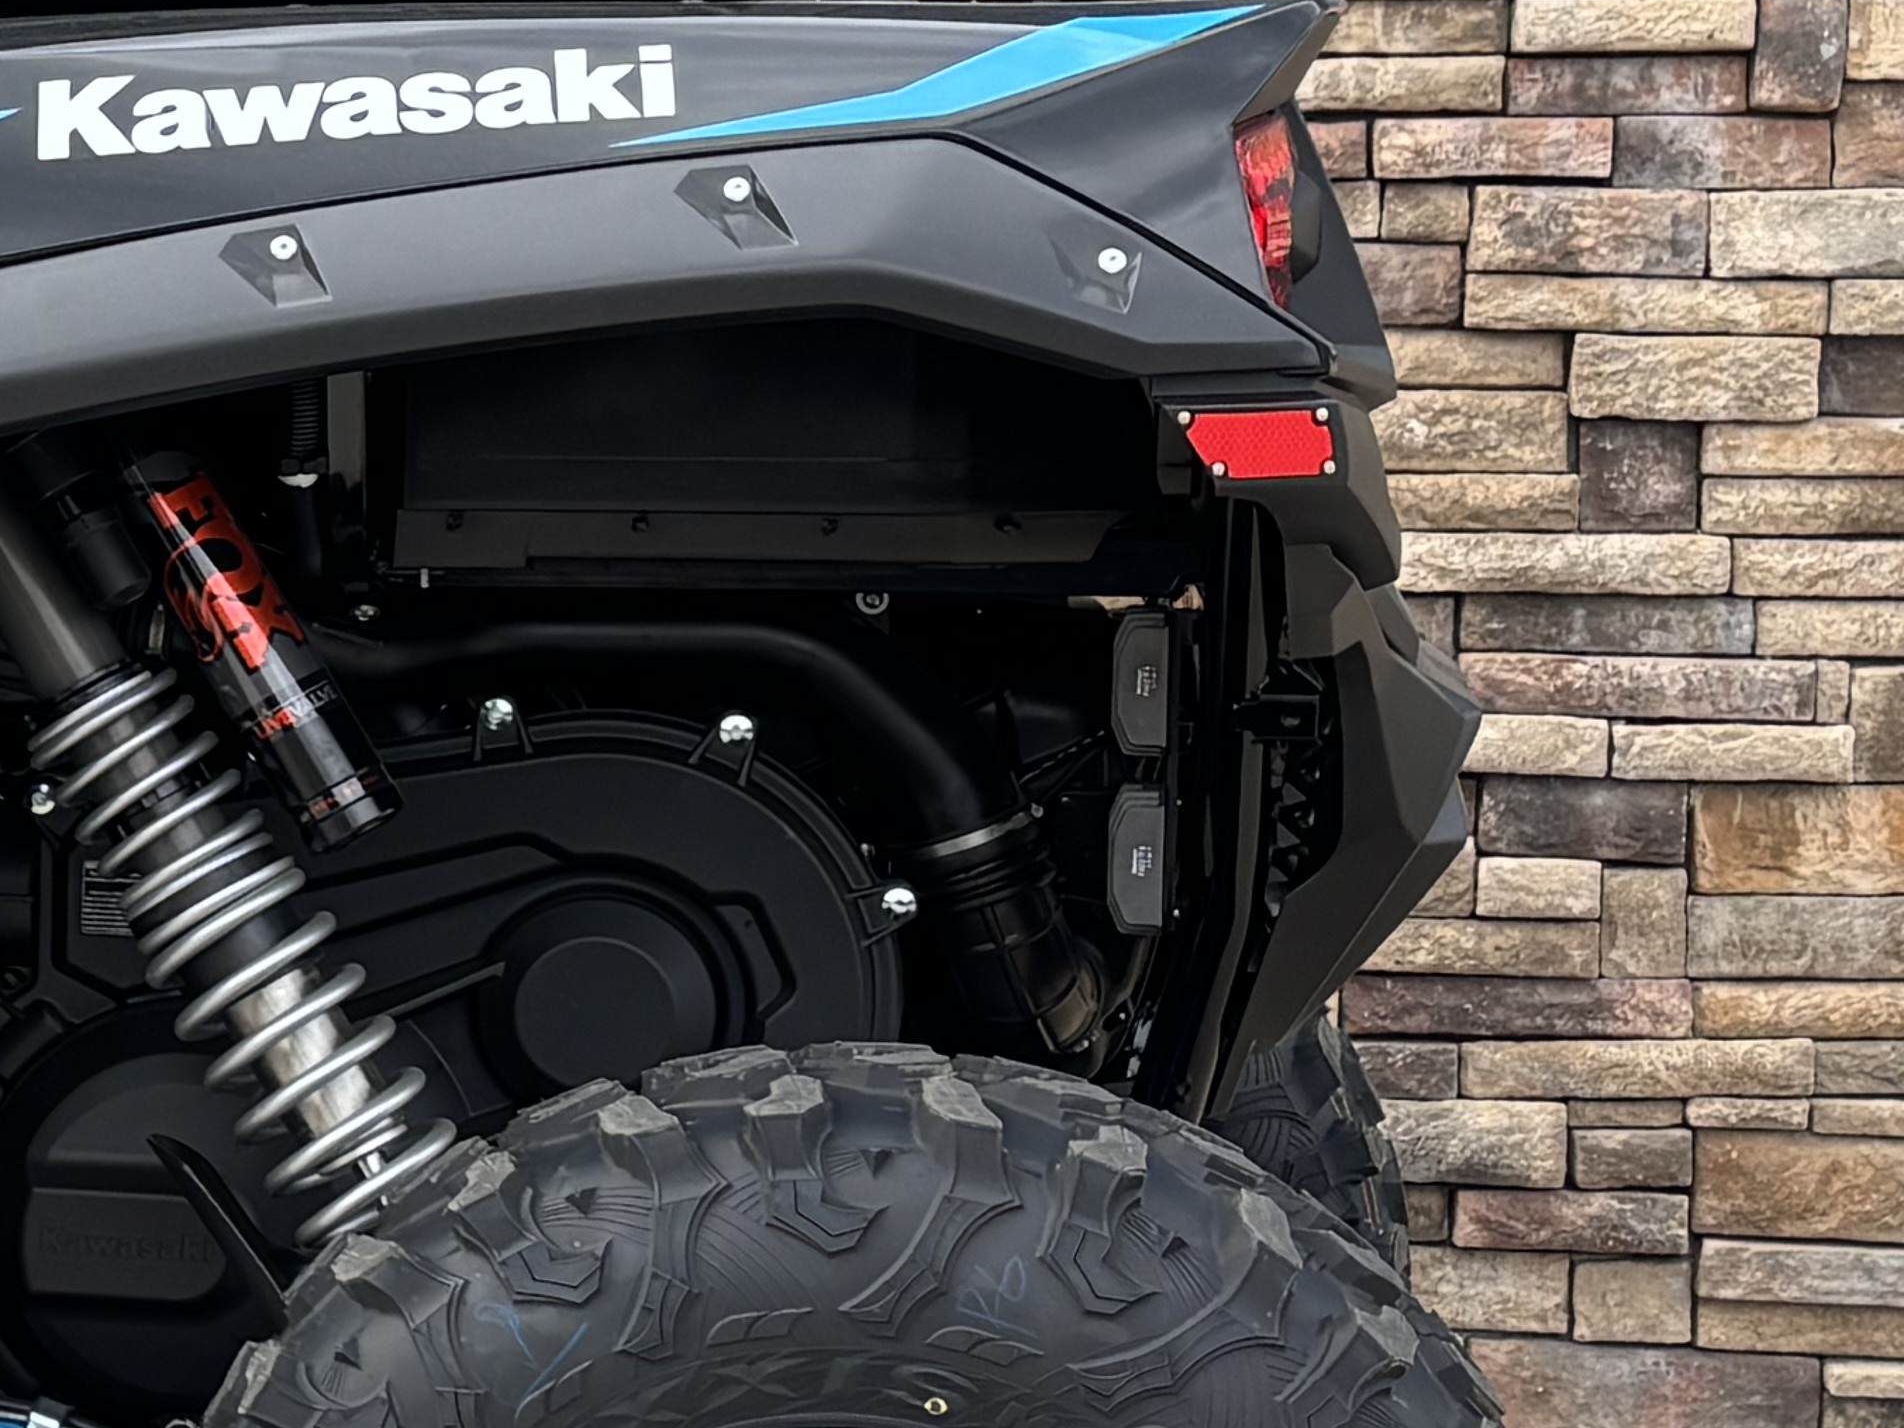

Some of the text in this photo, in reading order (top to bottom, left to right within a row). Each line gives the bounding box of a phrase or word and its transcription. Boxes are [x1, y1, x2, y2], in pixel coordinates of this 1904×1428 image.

[37, 44, 676, 161] Kawasaki
[147, 473, 308, 670] FOX
[41, 1222, 210, 1262] Kawasaki
